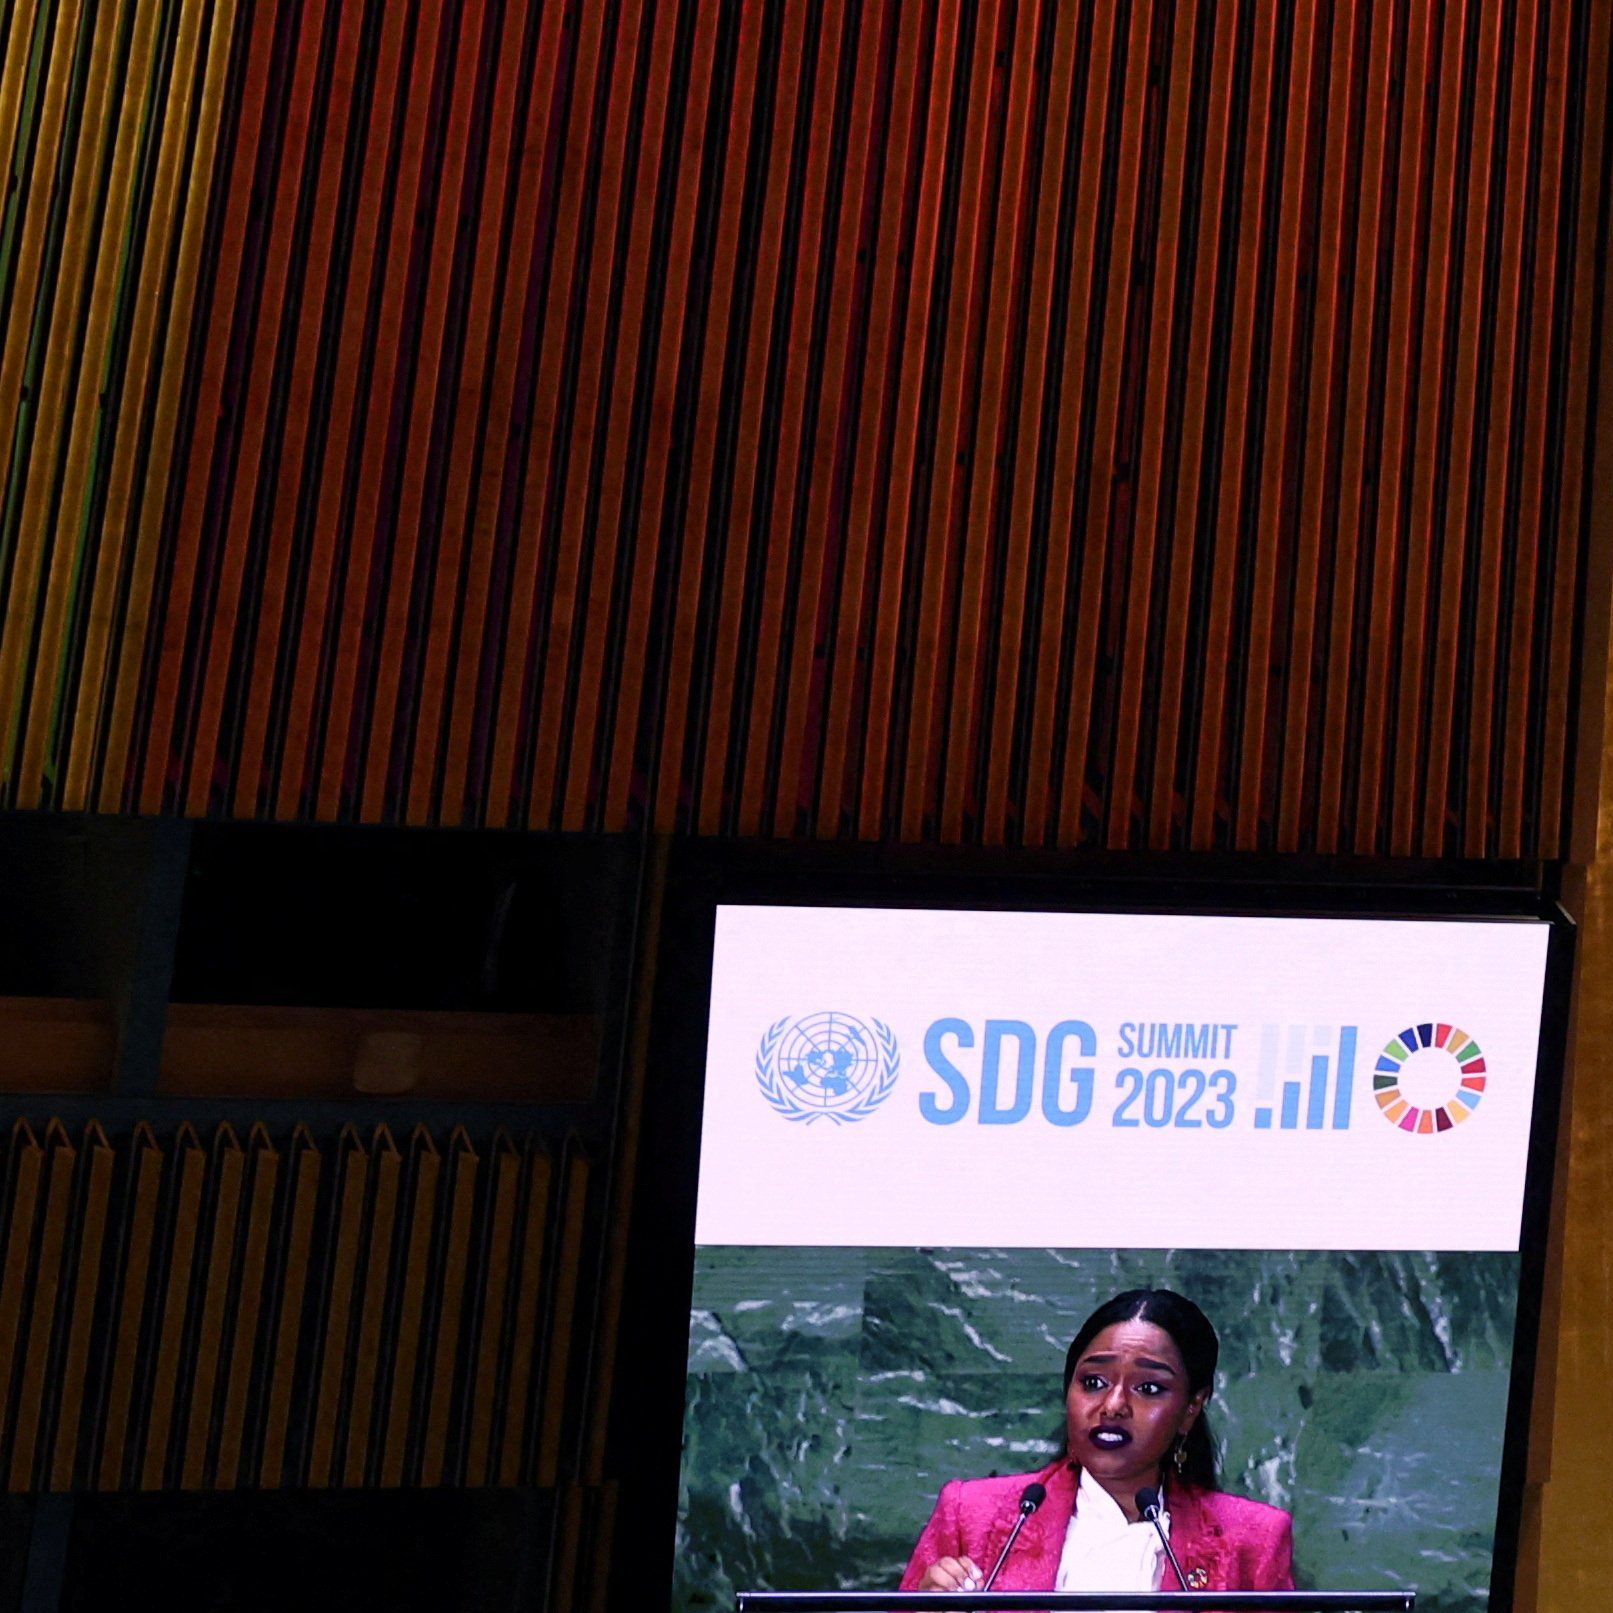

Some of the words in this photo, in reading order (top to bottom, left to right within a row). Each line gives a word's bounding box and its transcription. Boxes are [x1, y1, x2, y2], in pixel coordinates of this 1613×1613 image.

[919, 1017, 1098, 1128] SDG
[1117, 1022, 1238, 1060] SUMMIT
[1112, 1067, 1238, 1130] 2023
